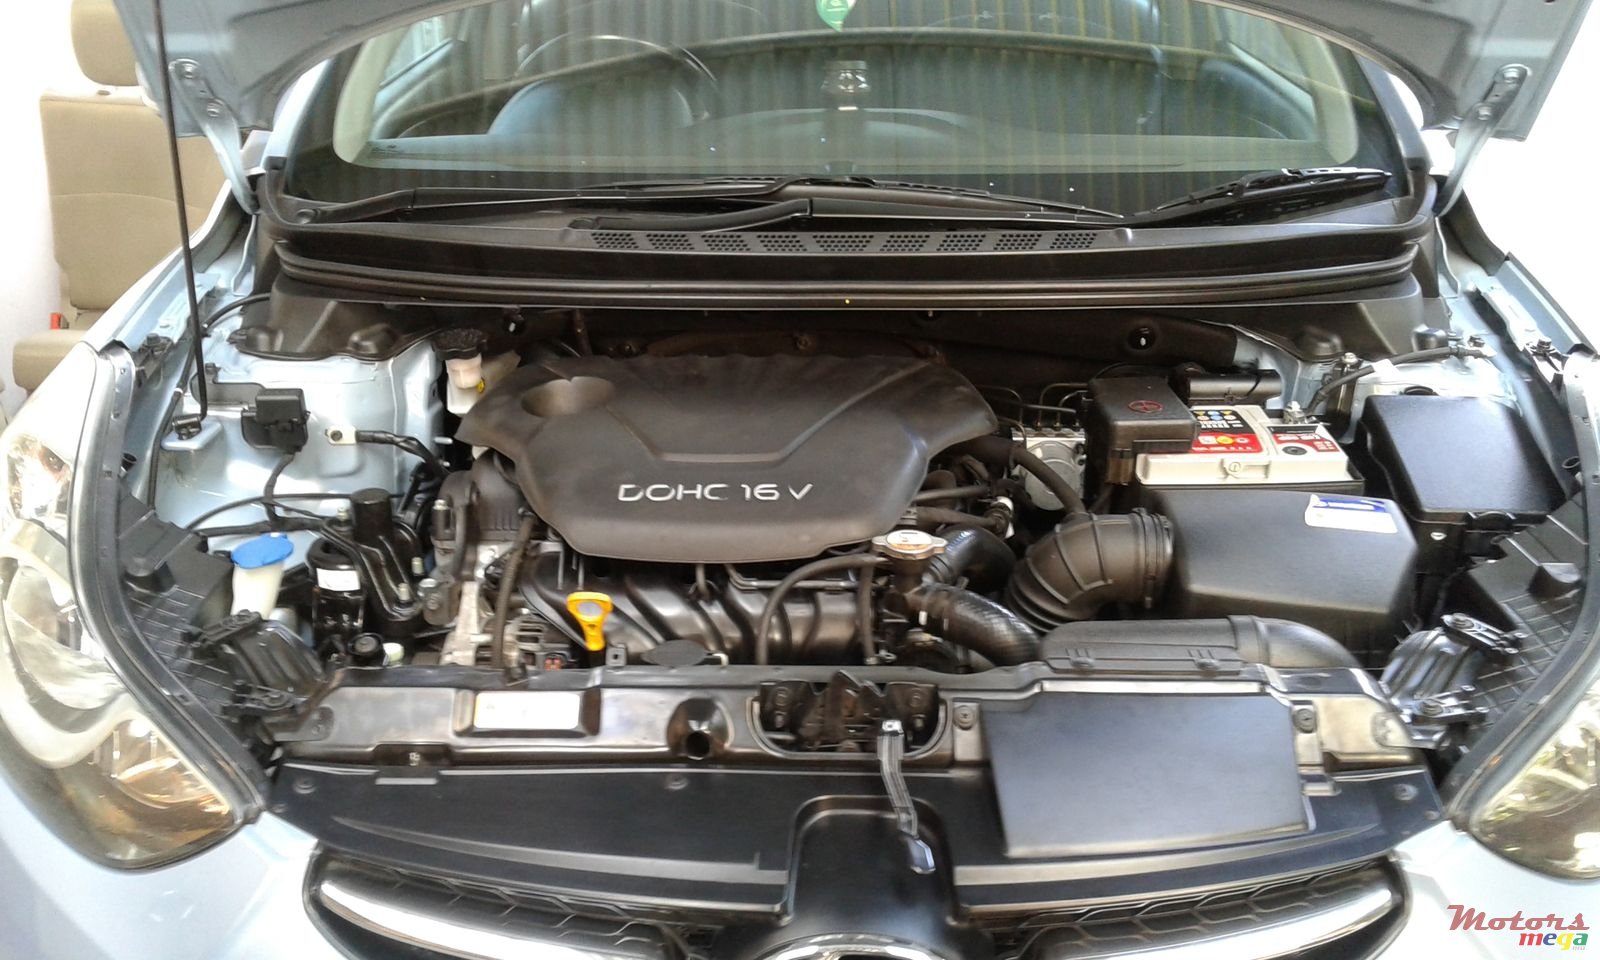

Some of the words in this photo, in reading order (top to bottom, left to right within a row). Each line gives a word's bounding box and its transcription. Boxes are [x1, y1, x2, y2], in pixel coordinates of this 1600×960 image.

[618, 483, 729, 502] DOHC
[741, 483, 780, 501] 16
[788, 483, 814, 501] V
